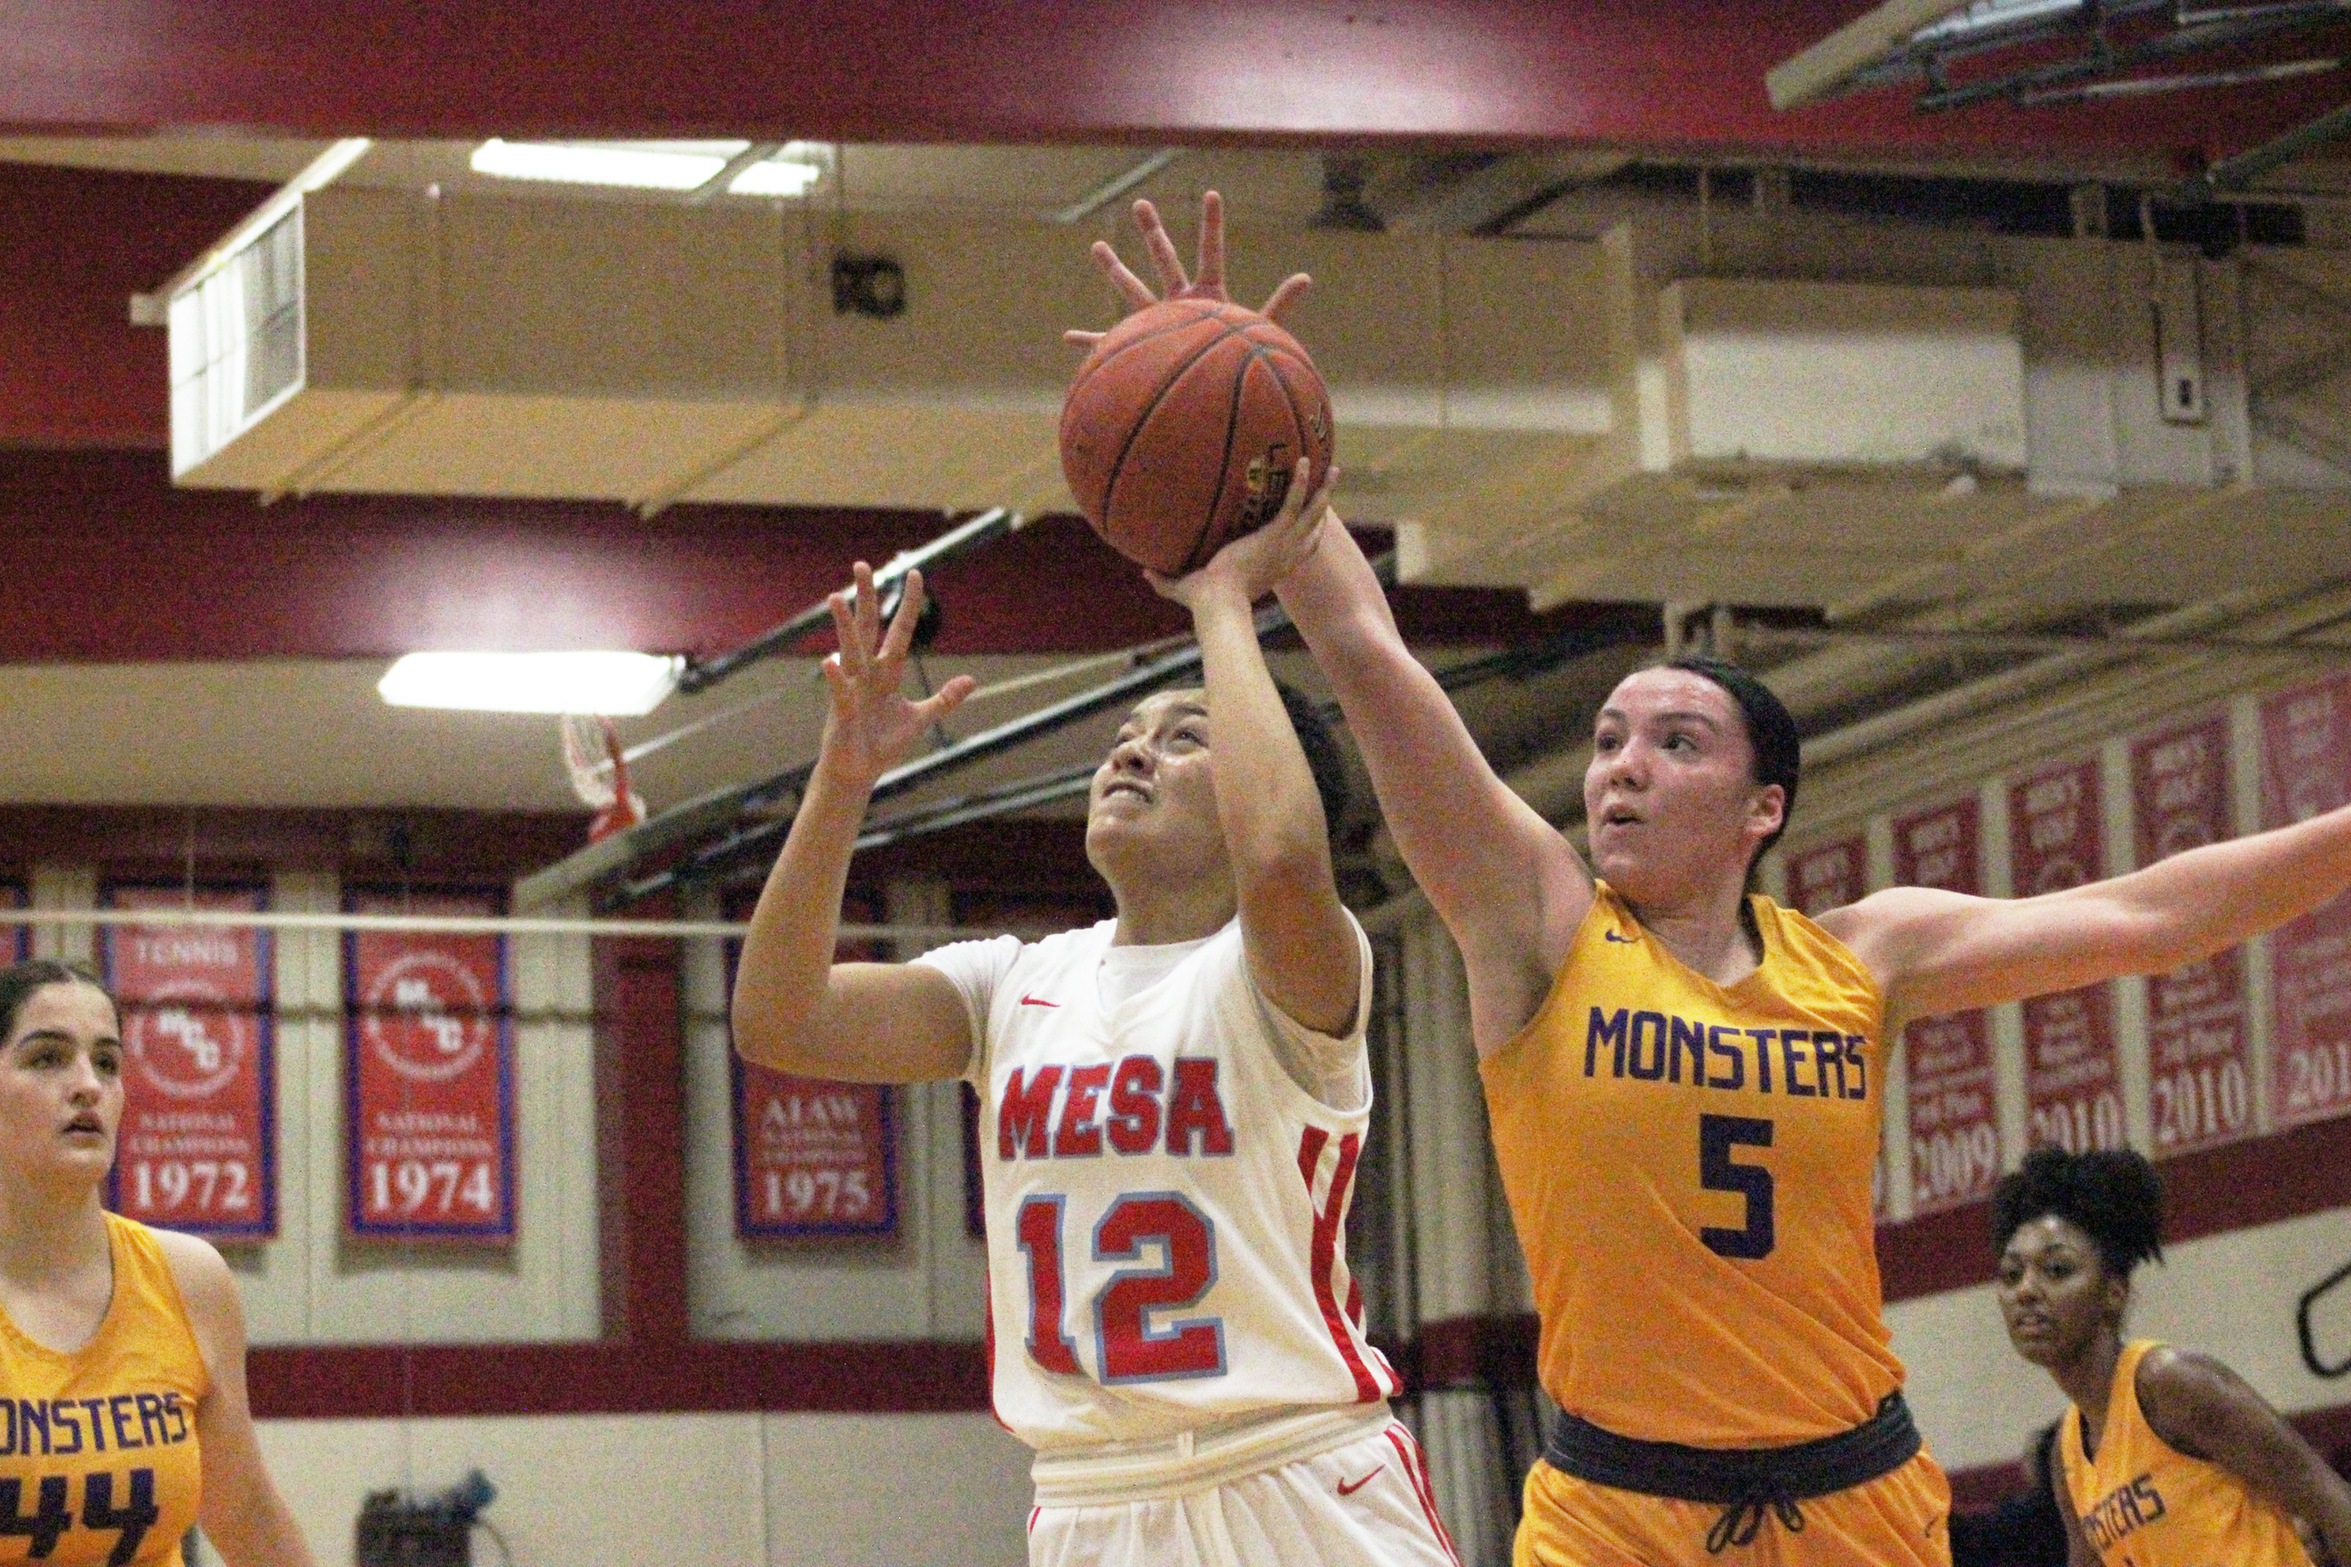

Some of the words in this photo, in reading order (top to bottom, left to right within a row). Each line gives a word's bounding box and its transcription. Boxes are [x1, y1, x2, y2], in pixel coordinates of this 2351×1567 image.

[1584, 1006, 1867, 1100] MONSTERS
[997, 1054, 1235, 1161] MESA
[2155, 1058, 2248, 1143] 2010
[132, 1160, 250, 1211] 1972
[371, 1160, 495, 1213] 1974
[762, 1168, 870, 1216] 1975
[1700, 1113, 1775, 1260] 5
[1016, 1191, 1228, 1386] 12
[0, 1468, 160, 1567] 44
